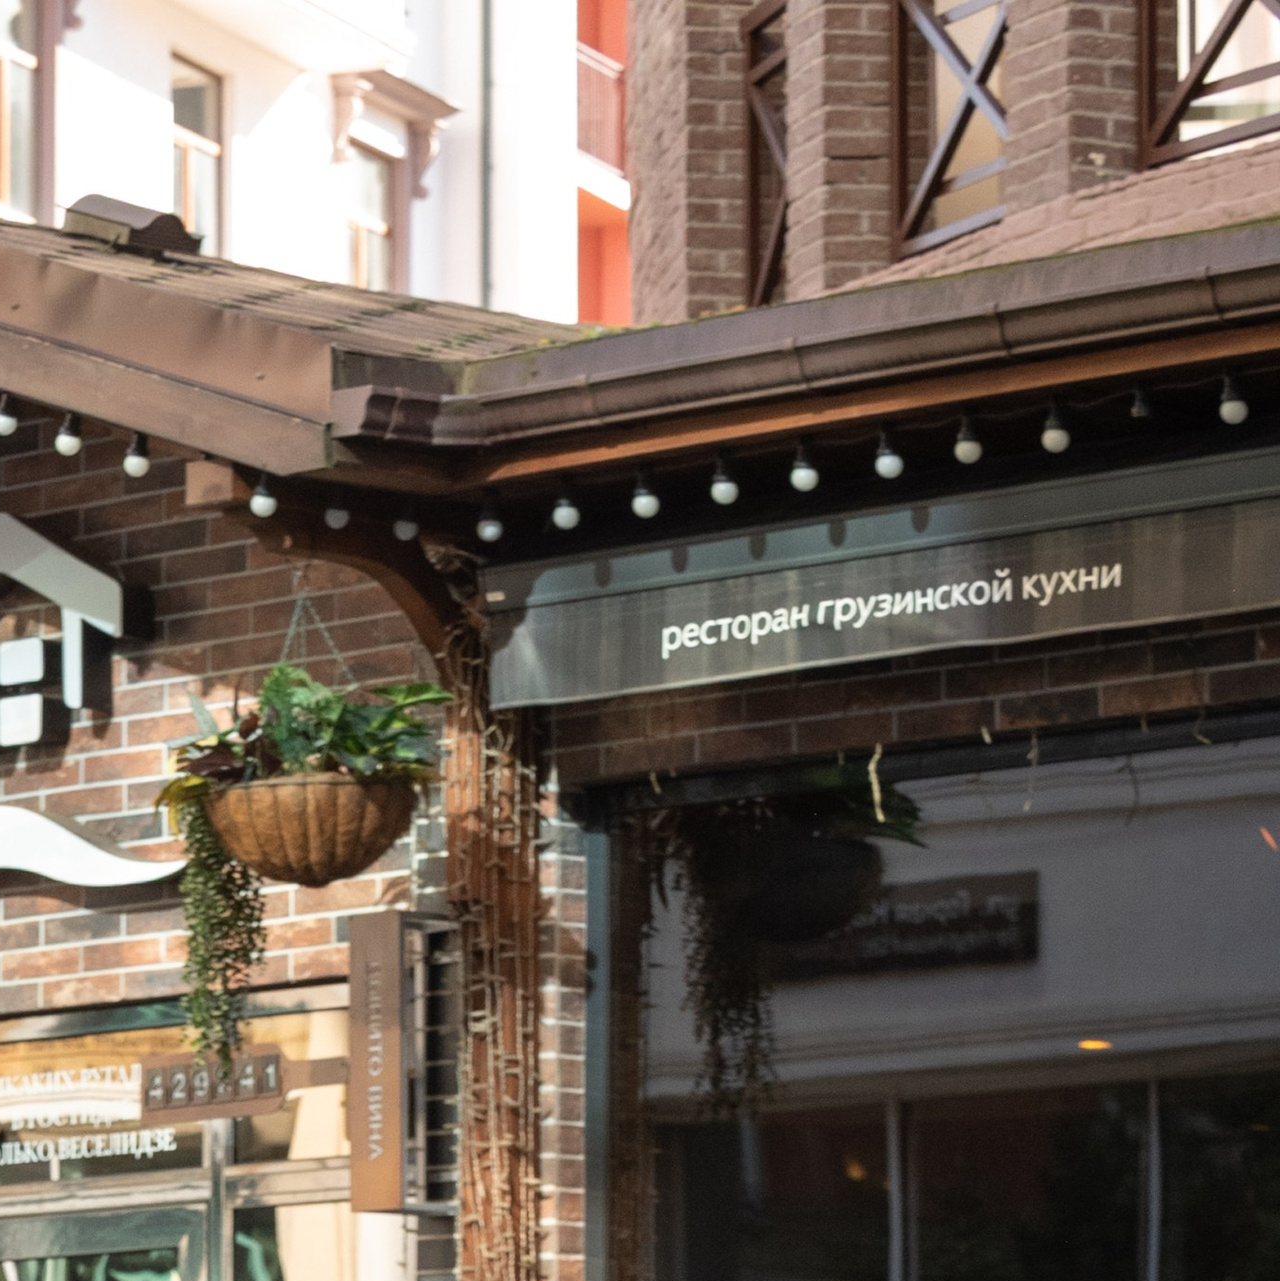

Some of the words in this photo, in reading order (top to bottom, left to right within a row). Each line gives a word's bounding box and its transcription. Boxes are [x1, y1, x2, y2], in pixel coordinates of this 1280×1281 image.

[661, 603, 810, 659] ресторан
[817, 568, 1012, 631] грузинской
[1021, 563, 1122, 606] кухни
